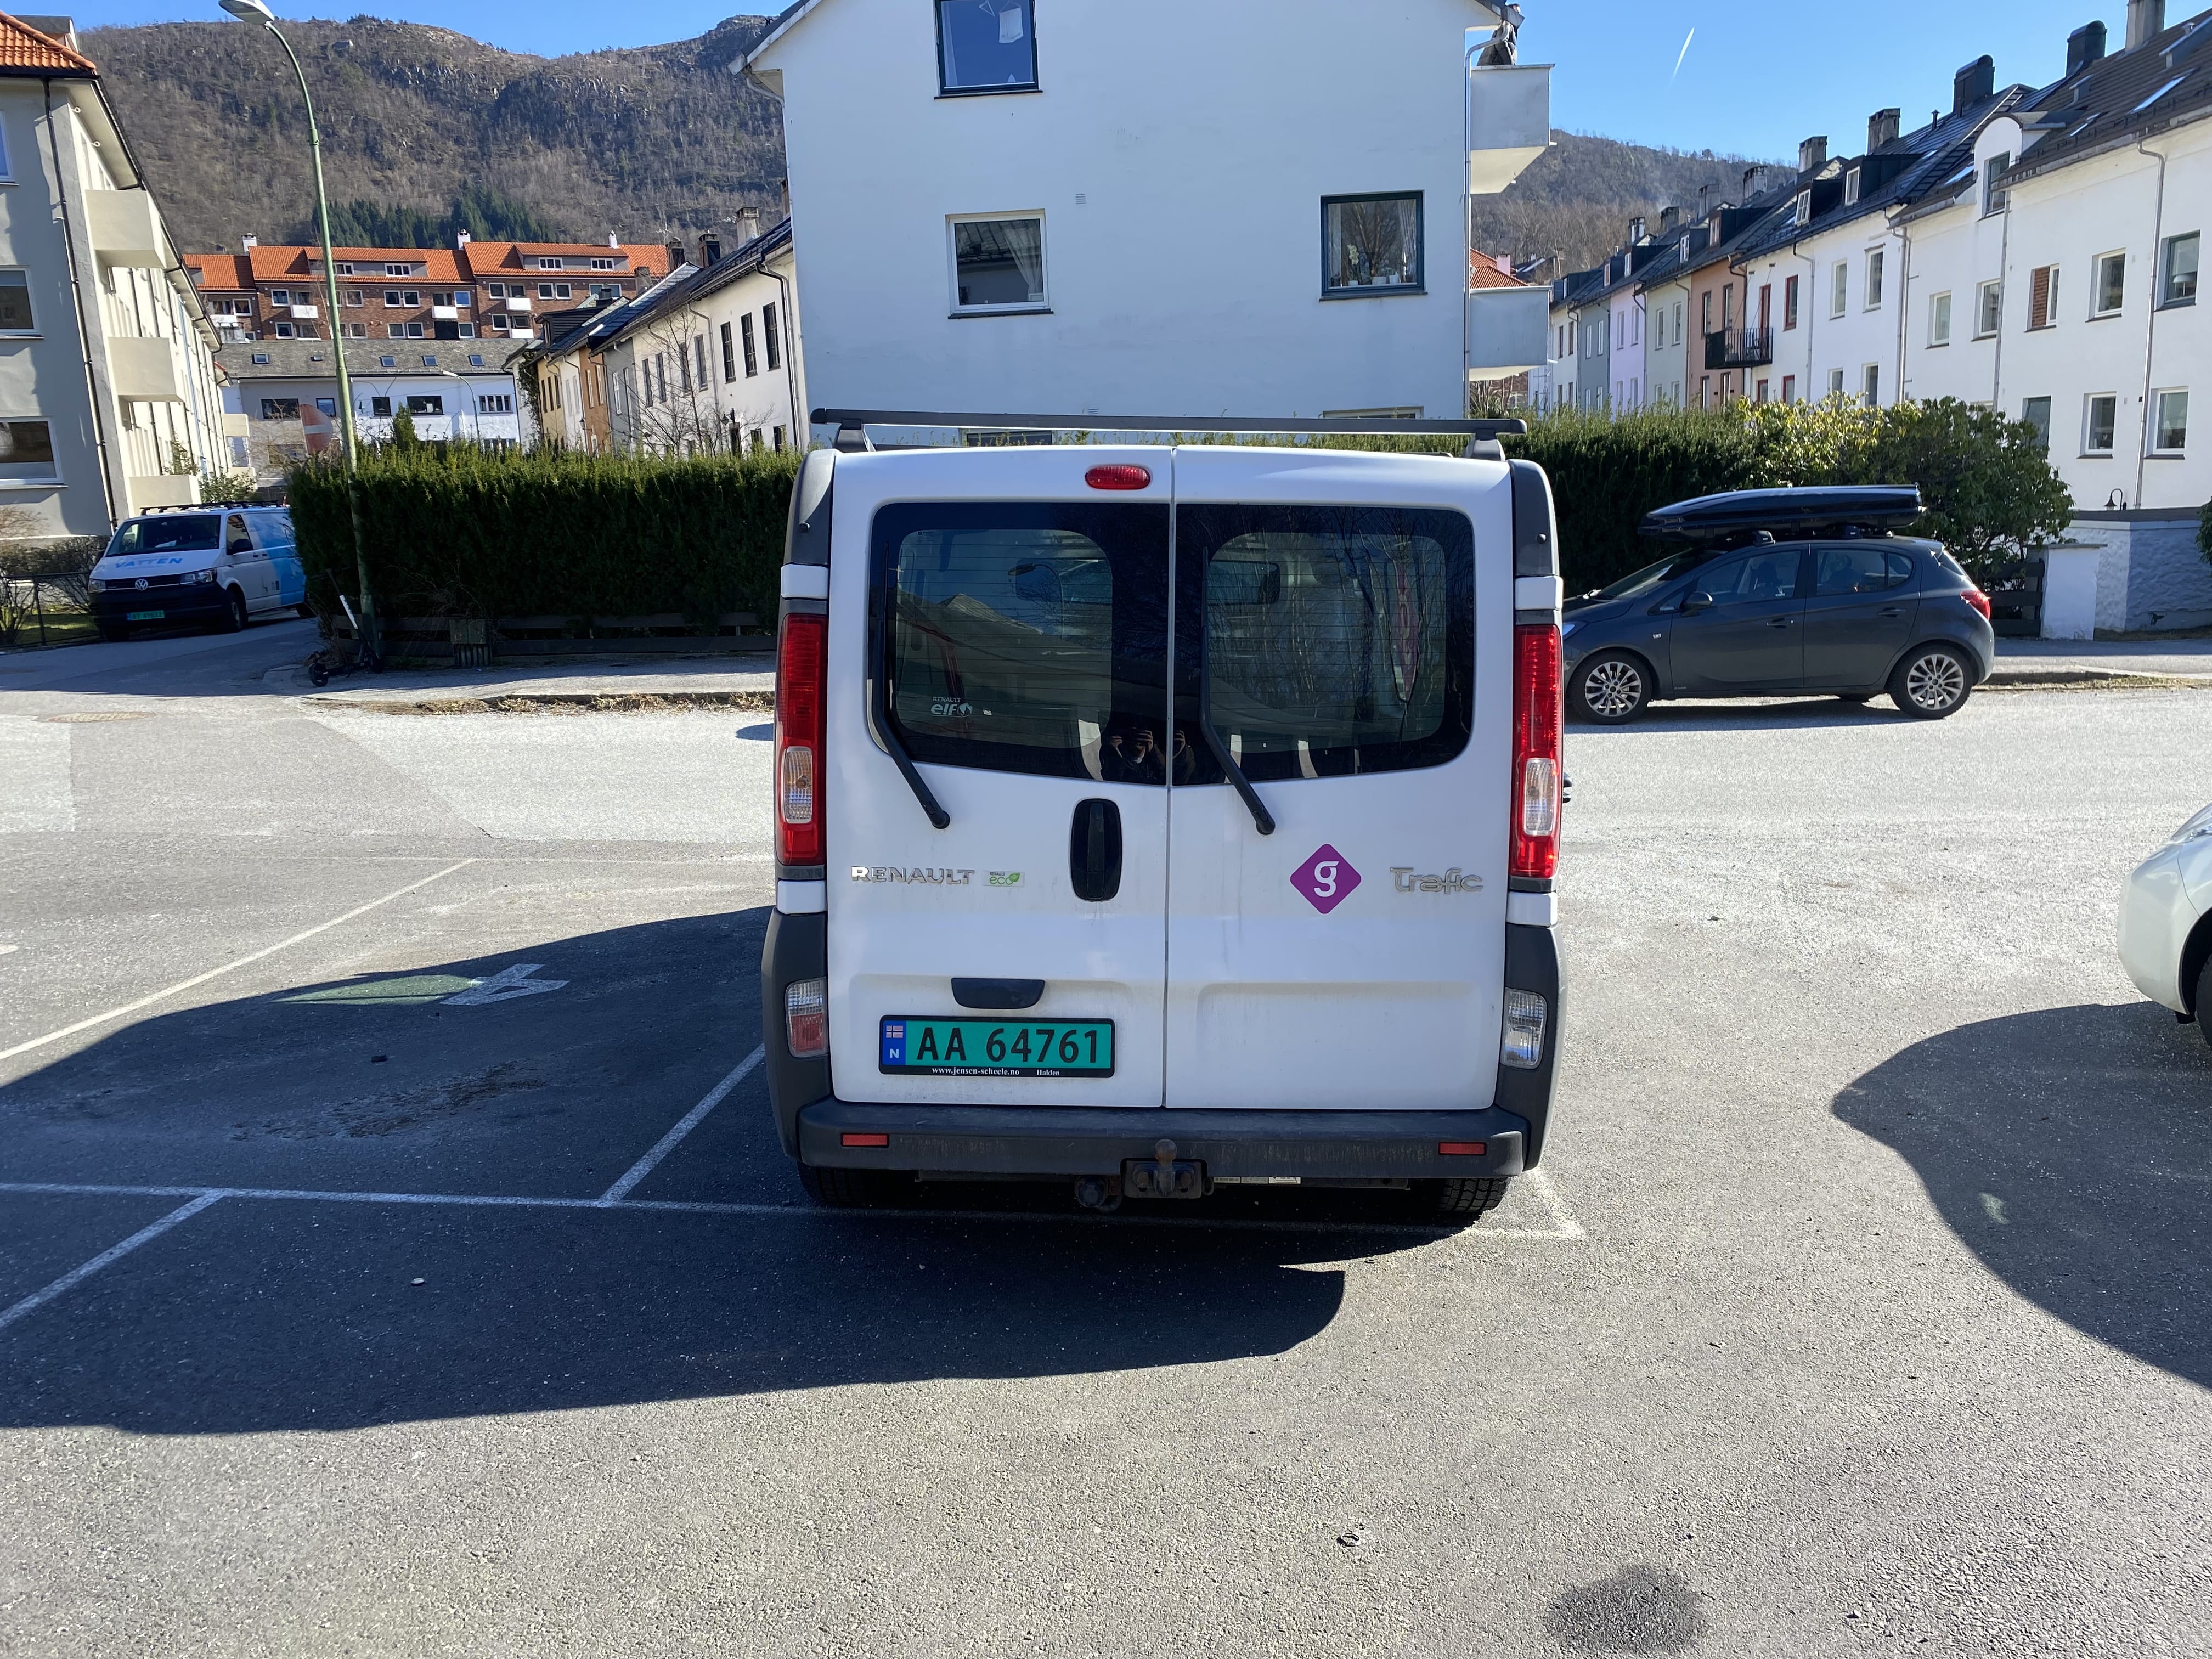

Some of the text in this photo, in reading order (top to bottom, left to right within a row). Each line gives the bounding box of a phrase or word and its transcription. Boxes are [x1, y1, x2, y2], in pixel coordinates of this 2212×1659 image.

[930, 703, 958, 715] elf
[851, 866, 975, 885] RENAULT
[989, 876, 1013, 885] eco
[1390, 866, 1484, 895] Trafic
[916, 1026, 1098, 1063] AA 64761
[889, 1048, 900, 1059] N
[932, 1067, 1020, 1076] www.jensen-scheele.no
